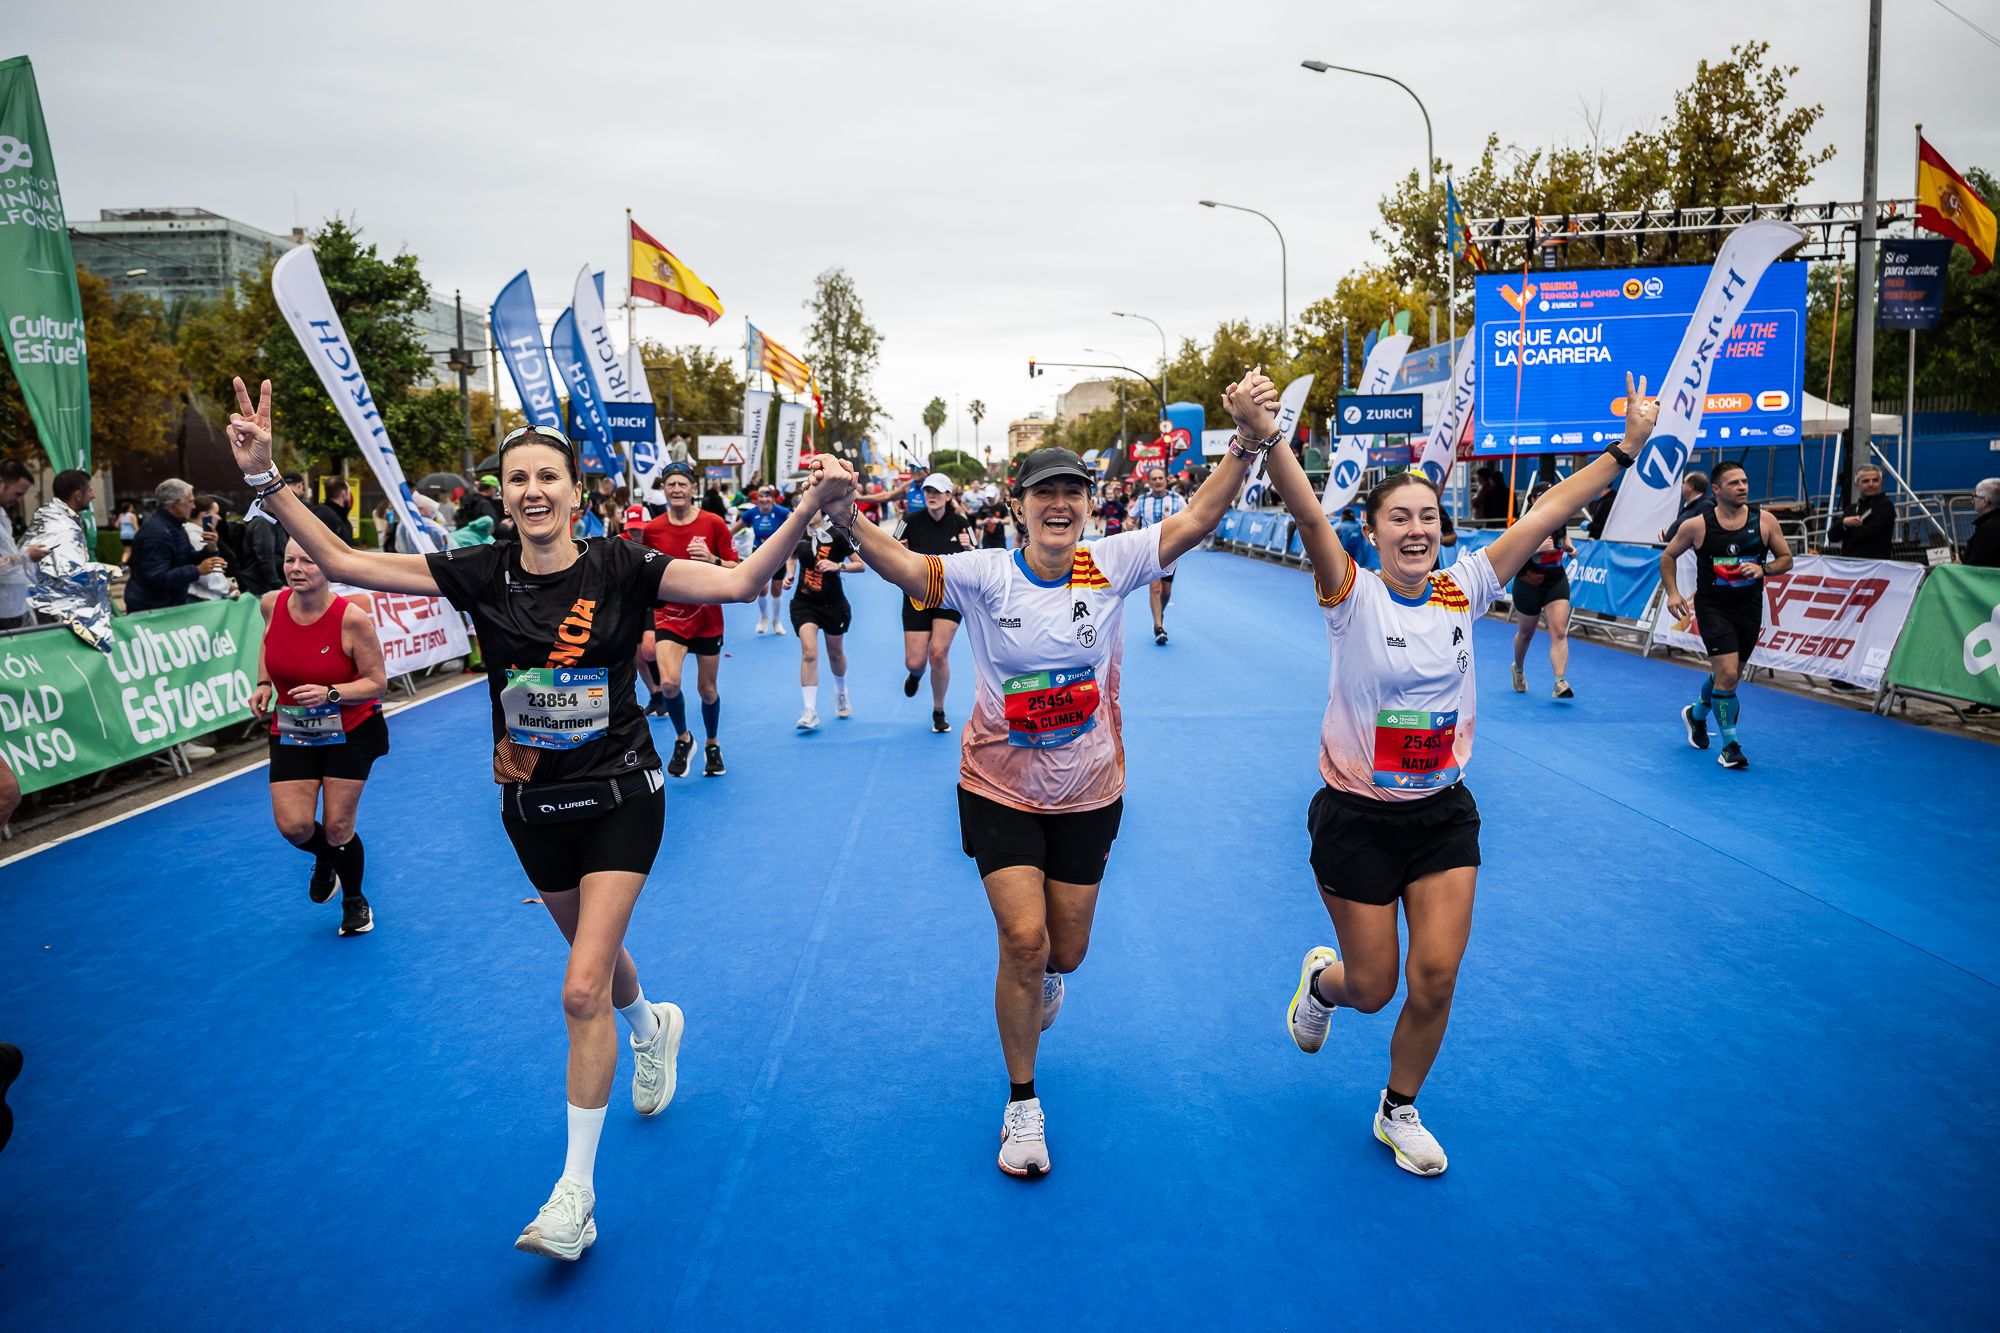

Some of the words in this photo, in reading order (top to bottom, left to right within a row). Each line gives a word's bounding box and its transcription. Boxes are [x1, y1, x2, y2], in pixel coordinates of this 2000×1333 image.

[1884, 265, 1905, 278] para
[1540, 291, 1579, 301] TRINIDAD
[1579, 289, 1620, 300] ALFONSO
[9, 314, 85, 340] Cultur
[1494, 328, 1552, 347] SIGUE
[1555, 323, 1603, 344] AQUÍ
[1725, 323, 1748, 339] W
[1749, 322, 1779, 339] THE
[1494, 350, 1519, 367] LA
[1522, 345, 1612, 366] CARRERA
[1725, 341, 1767, 359] HERE
[607, 416, 647, 429] URICH
[1366, 407, 1413, 421] ZURICH
[1574, 565, 1608, 585] ZURICH
[545, 598, 597, 670] NCIA
[212, 628, 238, 659] del
[121, 668, 253, 745] Esfuerzo
[527, 691, 579, 708] 23854
[1028, 691, 1074, 711] 25454
[518, 713, 593, 729] MariCarmen
[1040, 710, 1085, 729] CLIMEN
[558, 798, 599, 810] LURBEL
